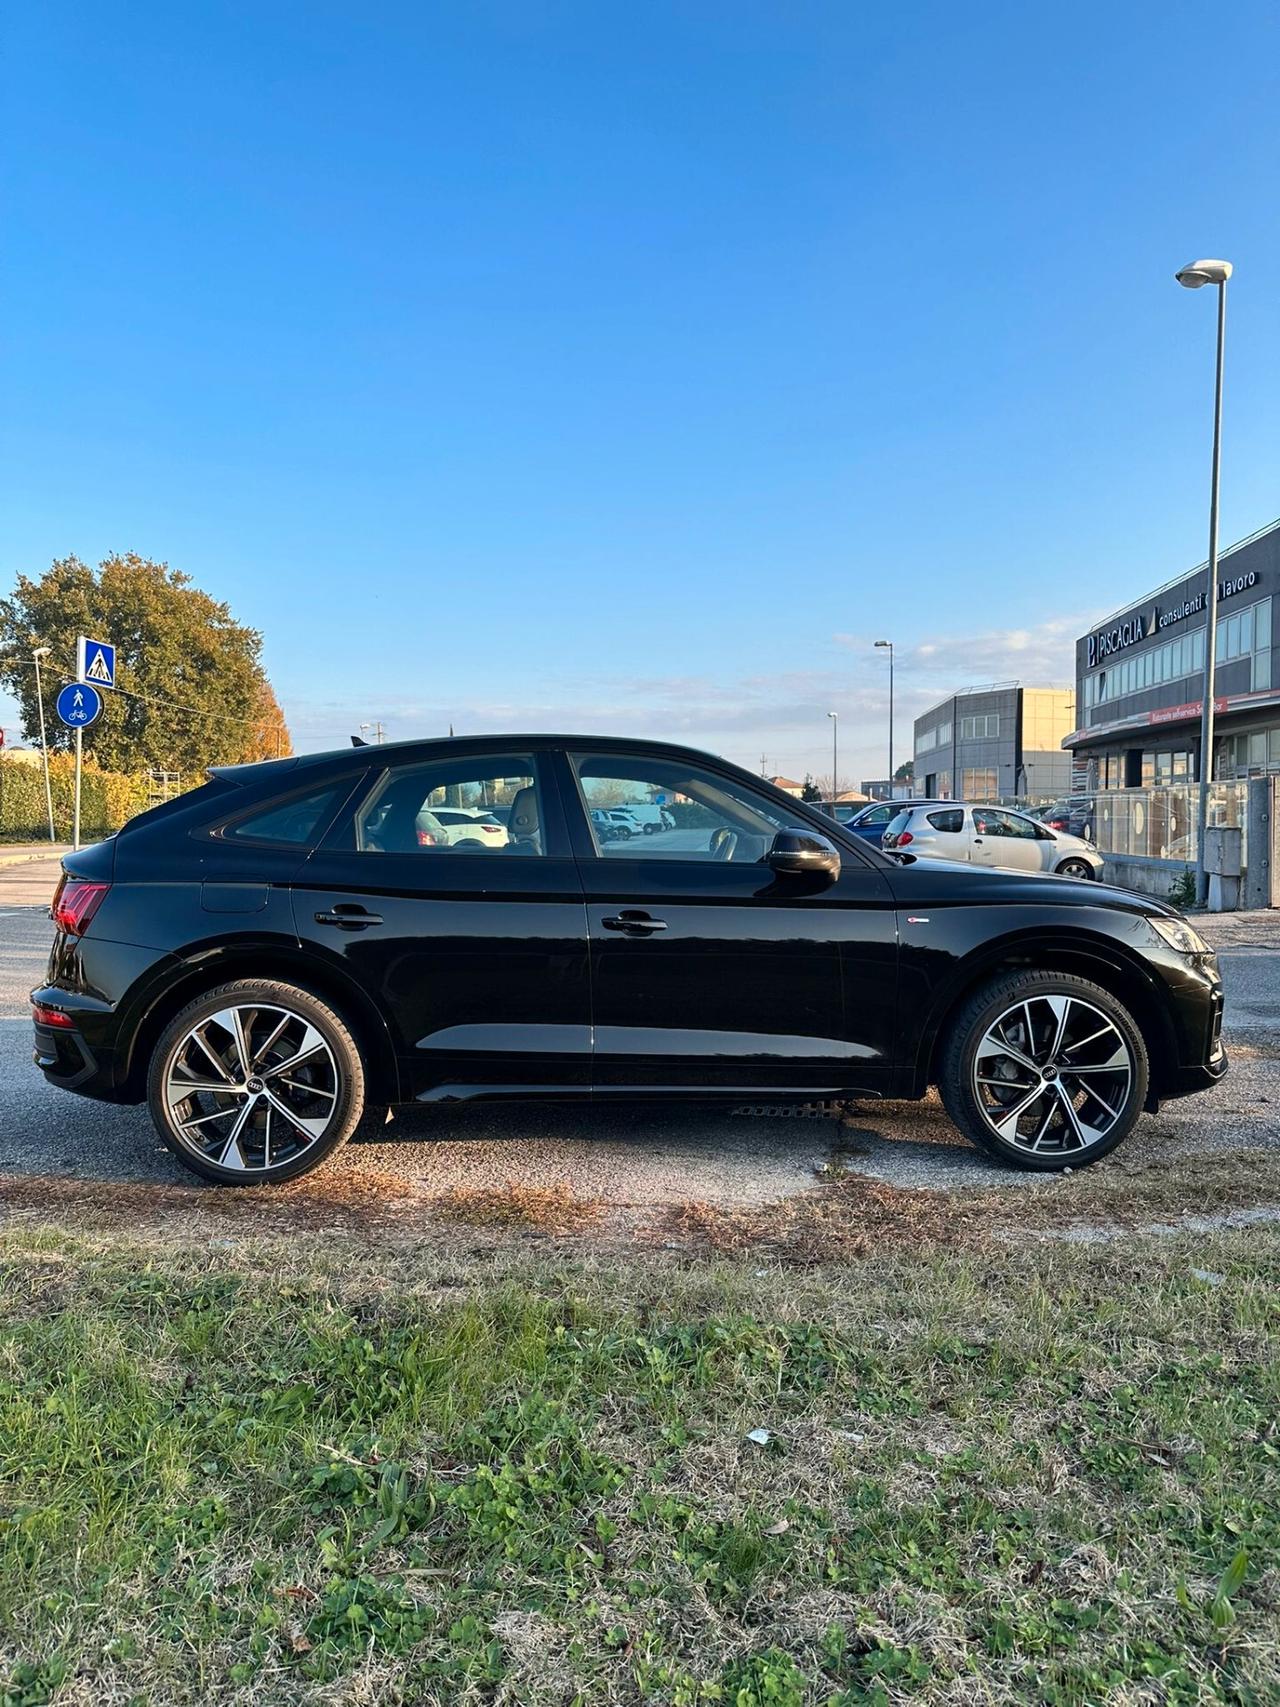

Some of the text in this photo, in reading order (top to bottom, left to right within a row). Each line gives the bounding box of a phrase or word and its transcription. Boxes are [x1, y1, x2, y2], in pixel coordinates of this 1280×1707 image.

[1100, 617, 1143, 657] PISCAGLIA
[1159, 592, 1202, 628] consulenti
[1222, 571, 1255, 598] lavoro
